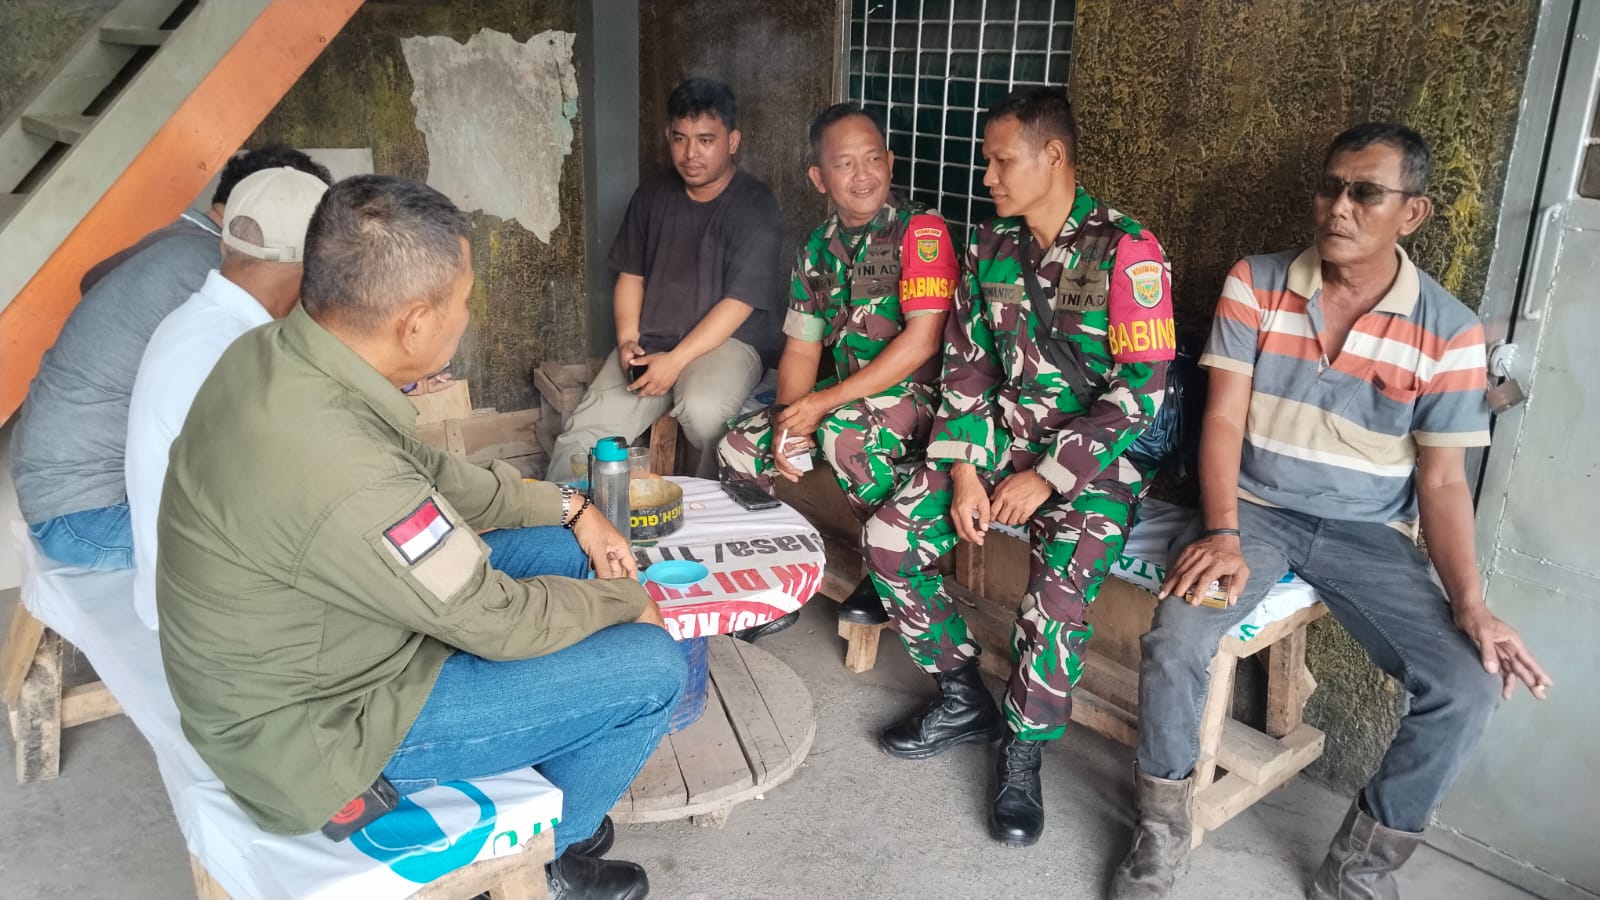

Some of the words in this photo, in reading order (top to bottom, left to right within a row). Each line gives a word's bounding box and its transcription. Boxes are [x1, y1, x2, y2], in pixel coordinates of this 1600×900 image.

[857, 264, 875, 276] TNI
[880, 264, 898, 275] AD
[1060, 293, 1080, 308] TNI
[1083, 294, 1106, 307] AD
[712, 568, 769, 594] DI
